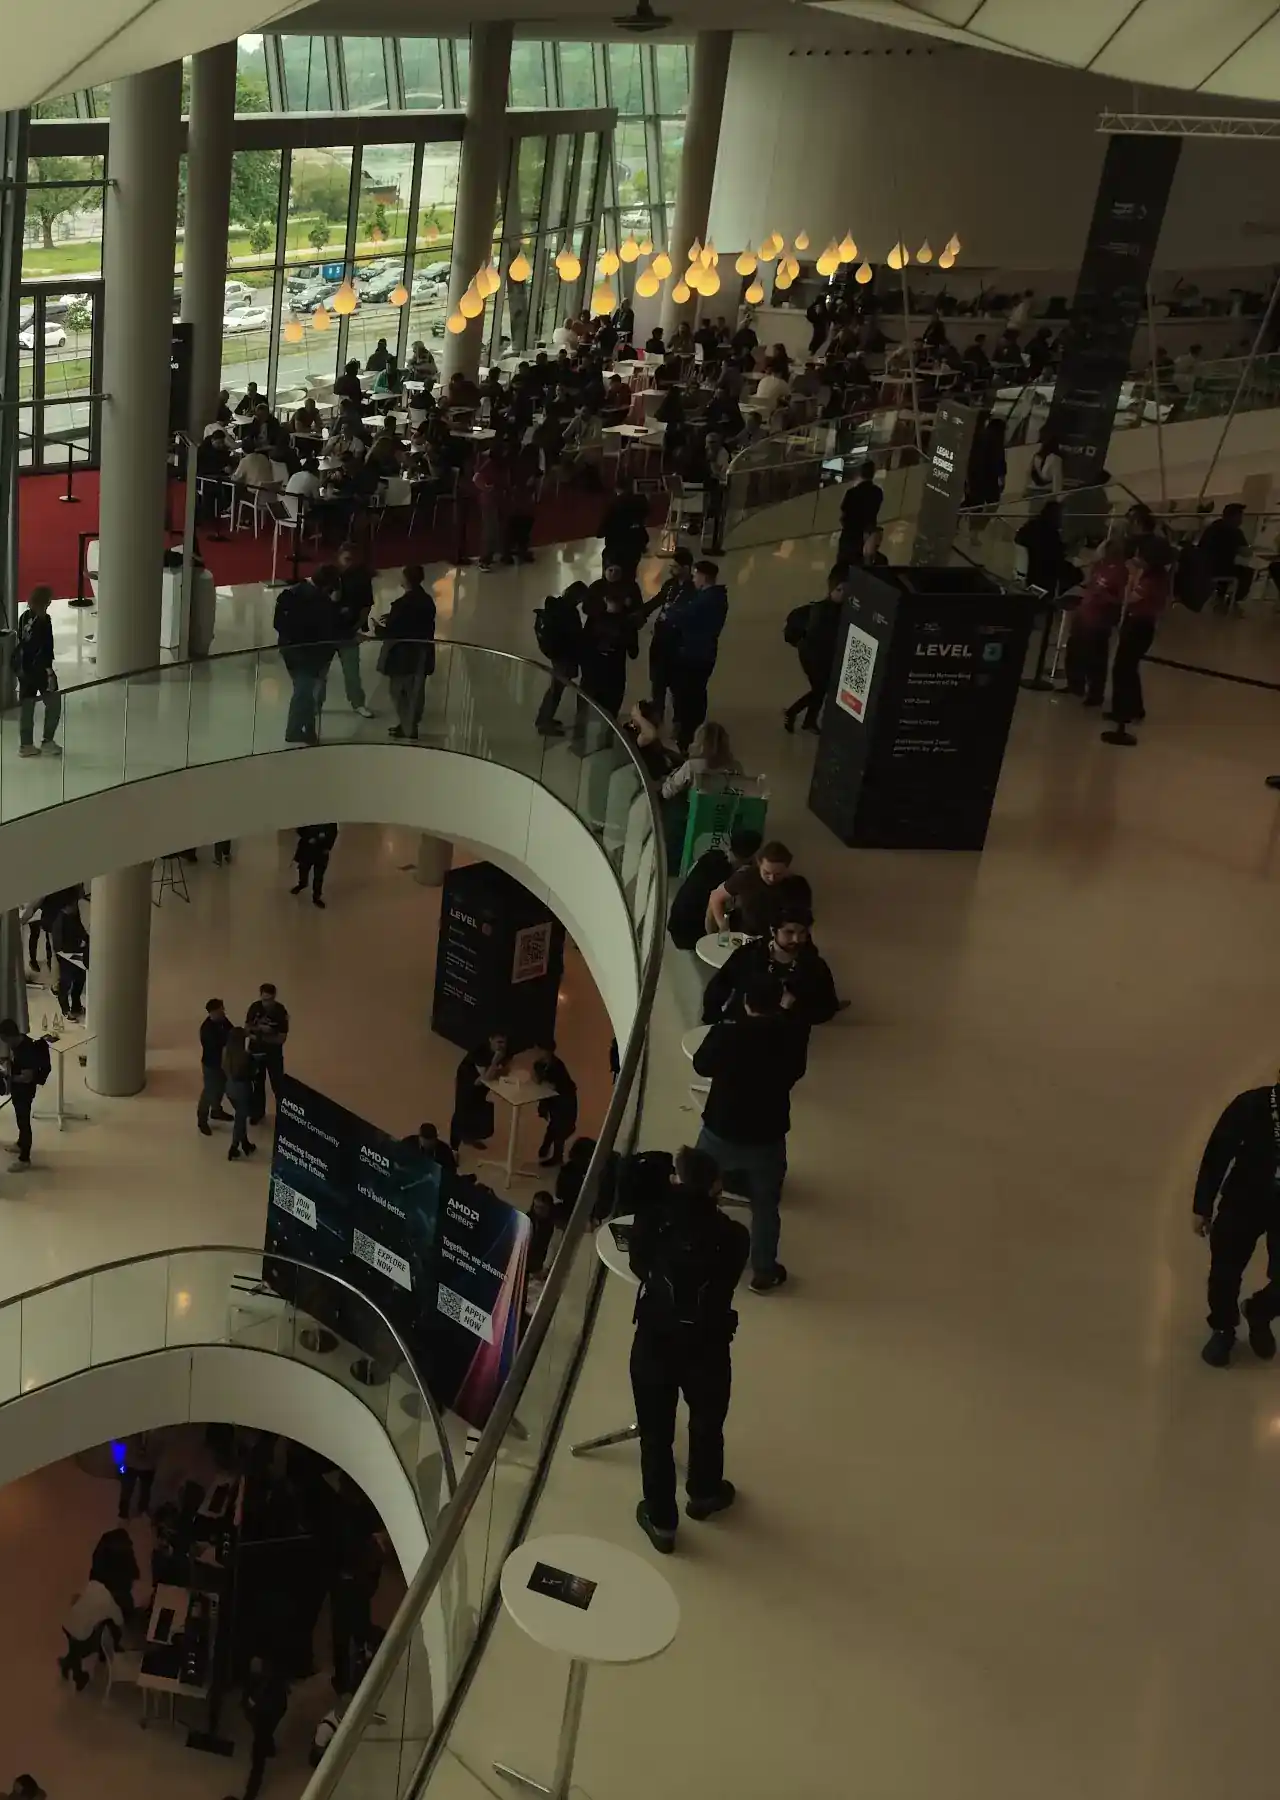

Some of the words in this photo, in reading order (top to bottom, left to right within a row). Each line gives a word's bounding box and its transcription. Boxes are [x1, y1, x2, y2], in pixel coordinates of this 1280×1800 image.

[914, 642, 973, 659] LEVEL
[449, 907, 477, 929] LEVEL
[280, 1105, 307, 1127] Developer
[307, 1122, 340, 1148] Community
[278, 1134, 304, 1158] Advancing
[277, 1144, 298, 1166] Shaping
[298, 1158, 308, 1170] the
[296, 1198, 310, 1211] JOIN
[372, 1191, 386, 1208] build
[296, 1207, 311, 1221] NOW
[446, 1207, 474, 1230] Careers
[377, 1248, 406, 1272] EXPLORE
[441, 1247, 456, 1262] your
[472, 1255, 482, 1266] we
[377, 1259, 393, 1274] NOW
[465, 1305, 487, 1323] APPLY
[464, 1315, 482, 1332] NOW
